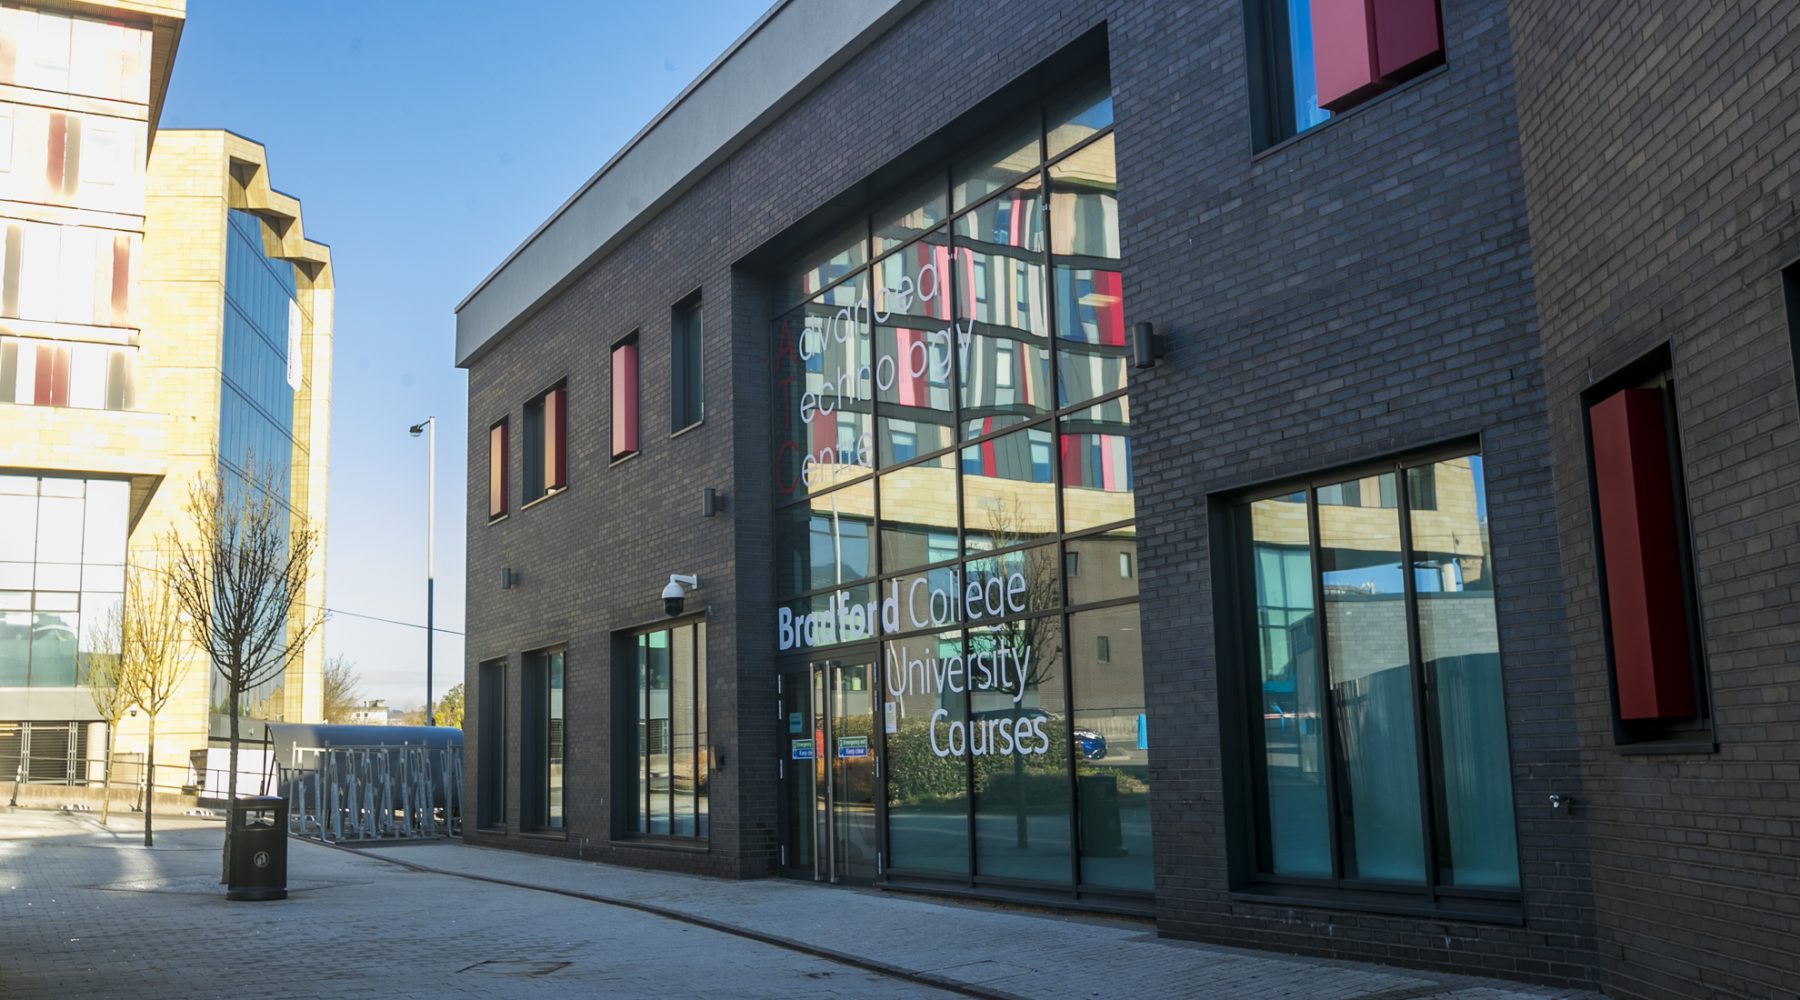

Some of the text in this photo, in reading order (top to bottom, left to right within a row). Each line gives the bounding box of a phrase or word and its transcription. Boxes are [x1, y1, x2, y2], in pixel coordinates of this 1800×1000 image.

[778, 569, 1026, 651] Bradford College
[886, 640, 1031, 703] University
[930, 708, 1049, 758] Courses
